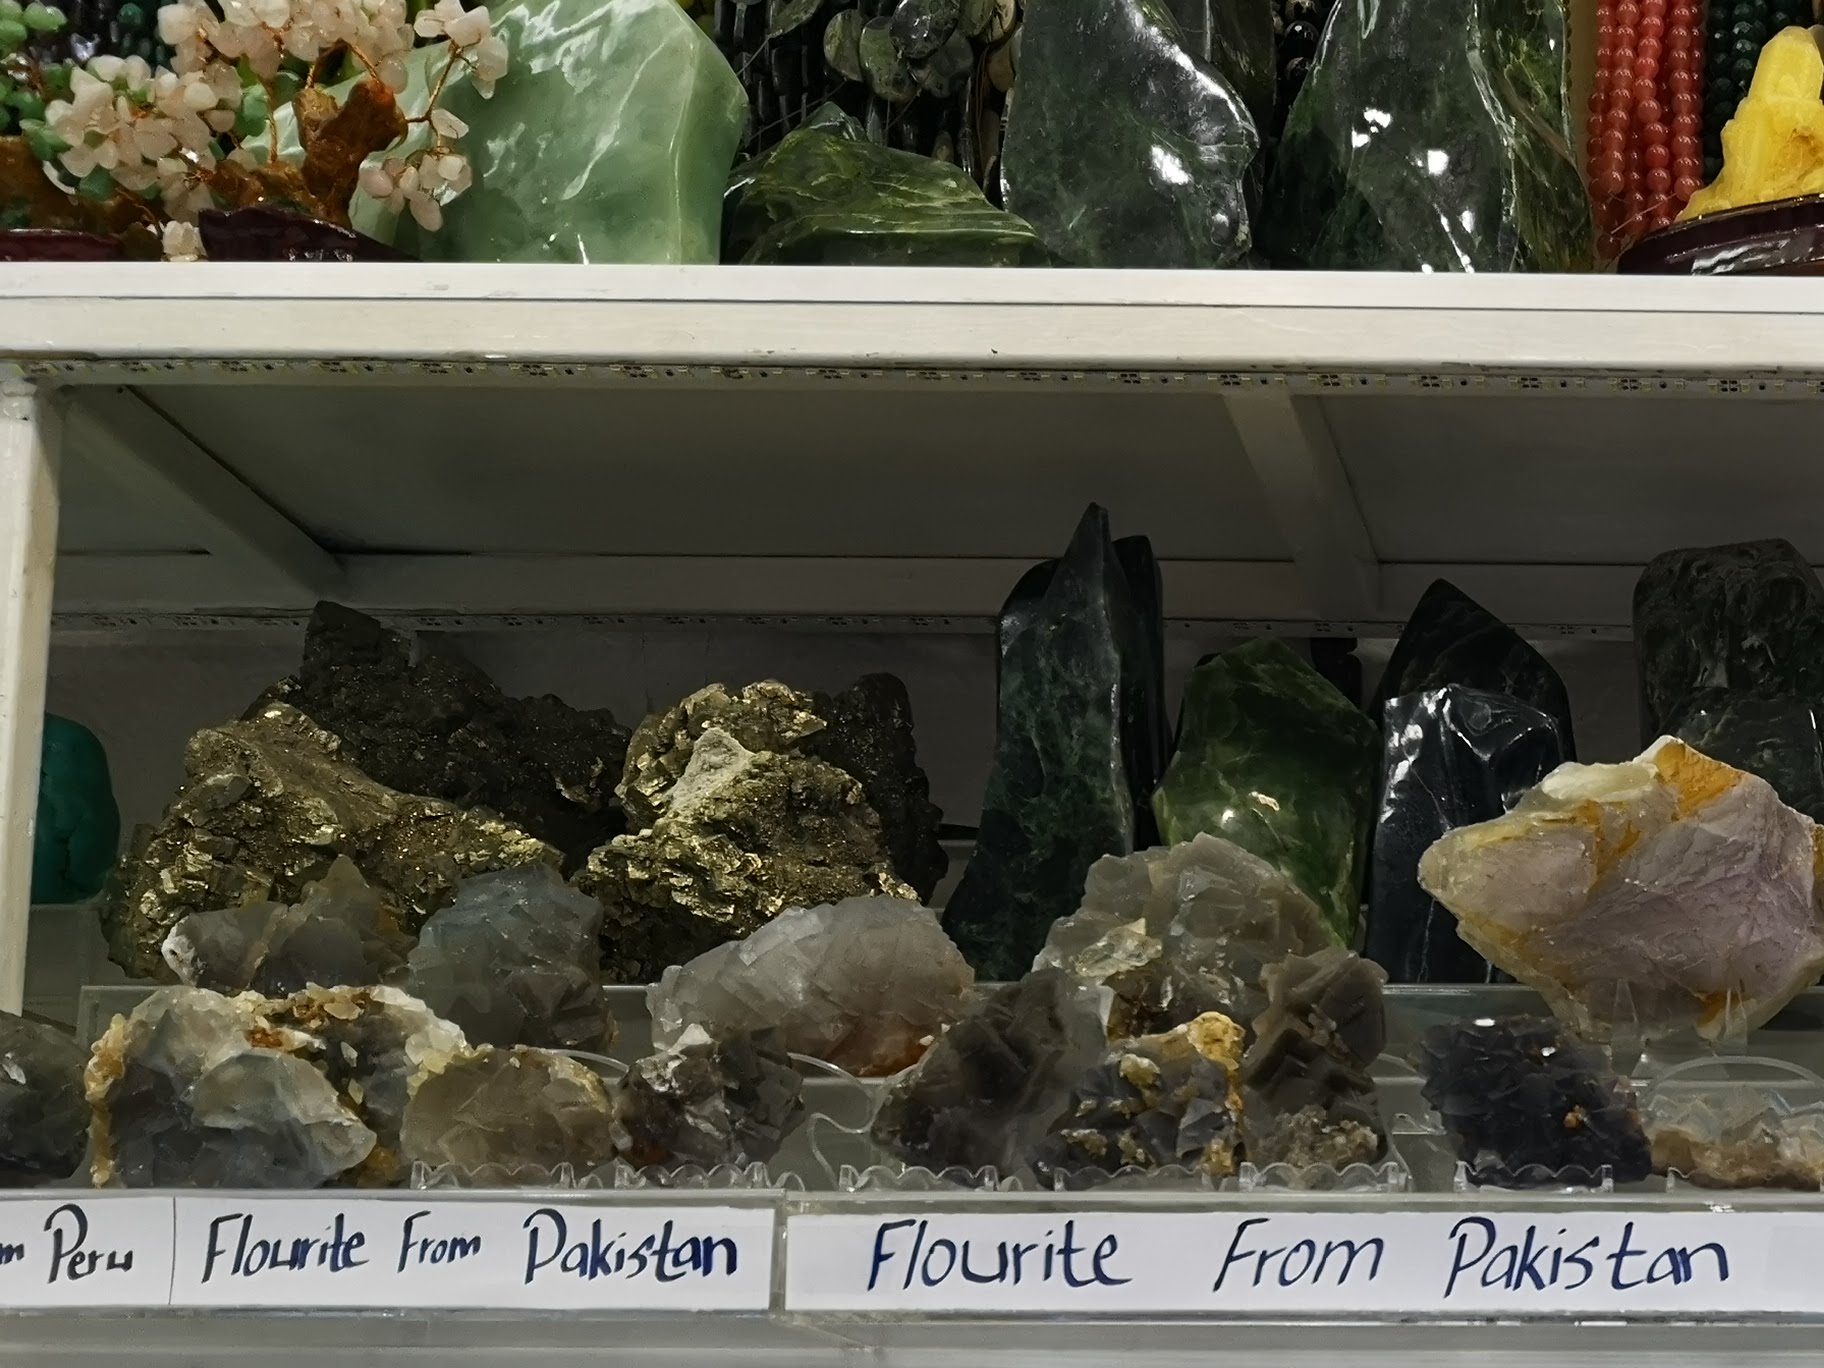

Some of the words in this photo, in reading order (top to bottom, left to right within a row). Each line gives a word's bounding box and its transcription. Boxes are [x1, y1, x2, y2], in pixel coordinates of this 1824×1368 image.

[43, 1202, 134, 1284] Peru
[200, 1212, 370, 1284] Flourite
[397, 1210, 482, 1273] From
[522, 1207, 738, 1285] Pakistan
[866, 1218, 1134, 1292] Flourite
[1212, 1217, 1385, 1293] From
[1443, 1215, 1730, 1299] Pakistan
